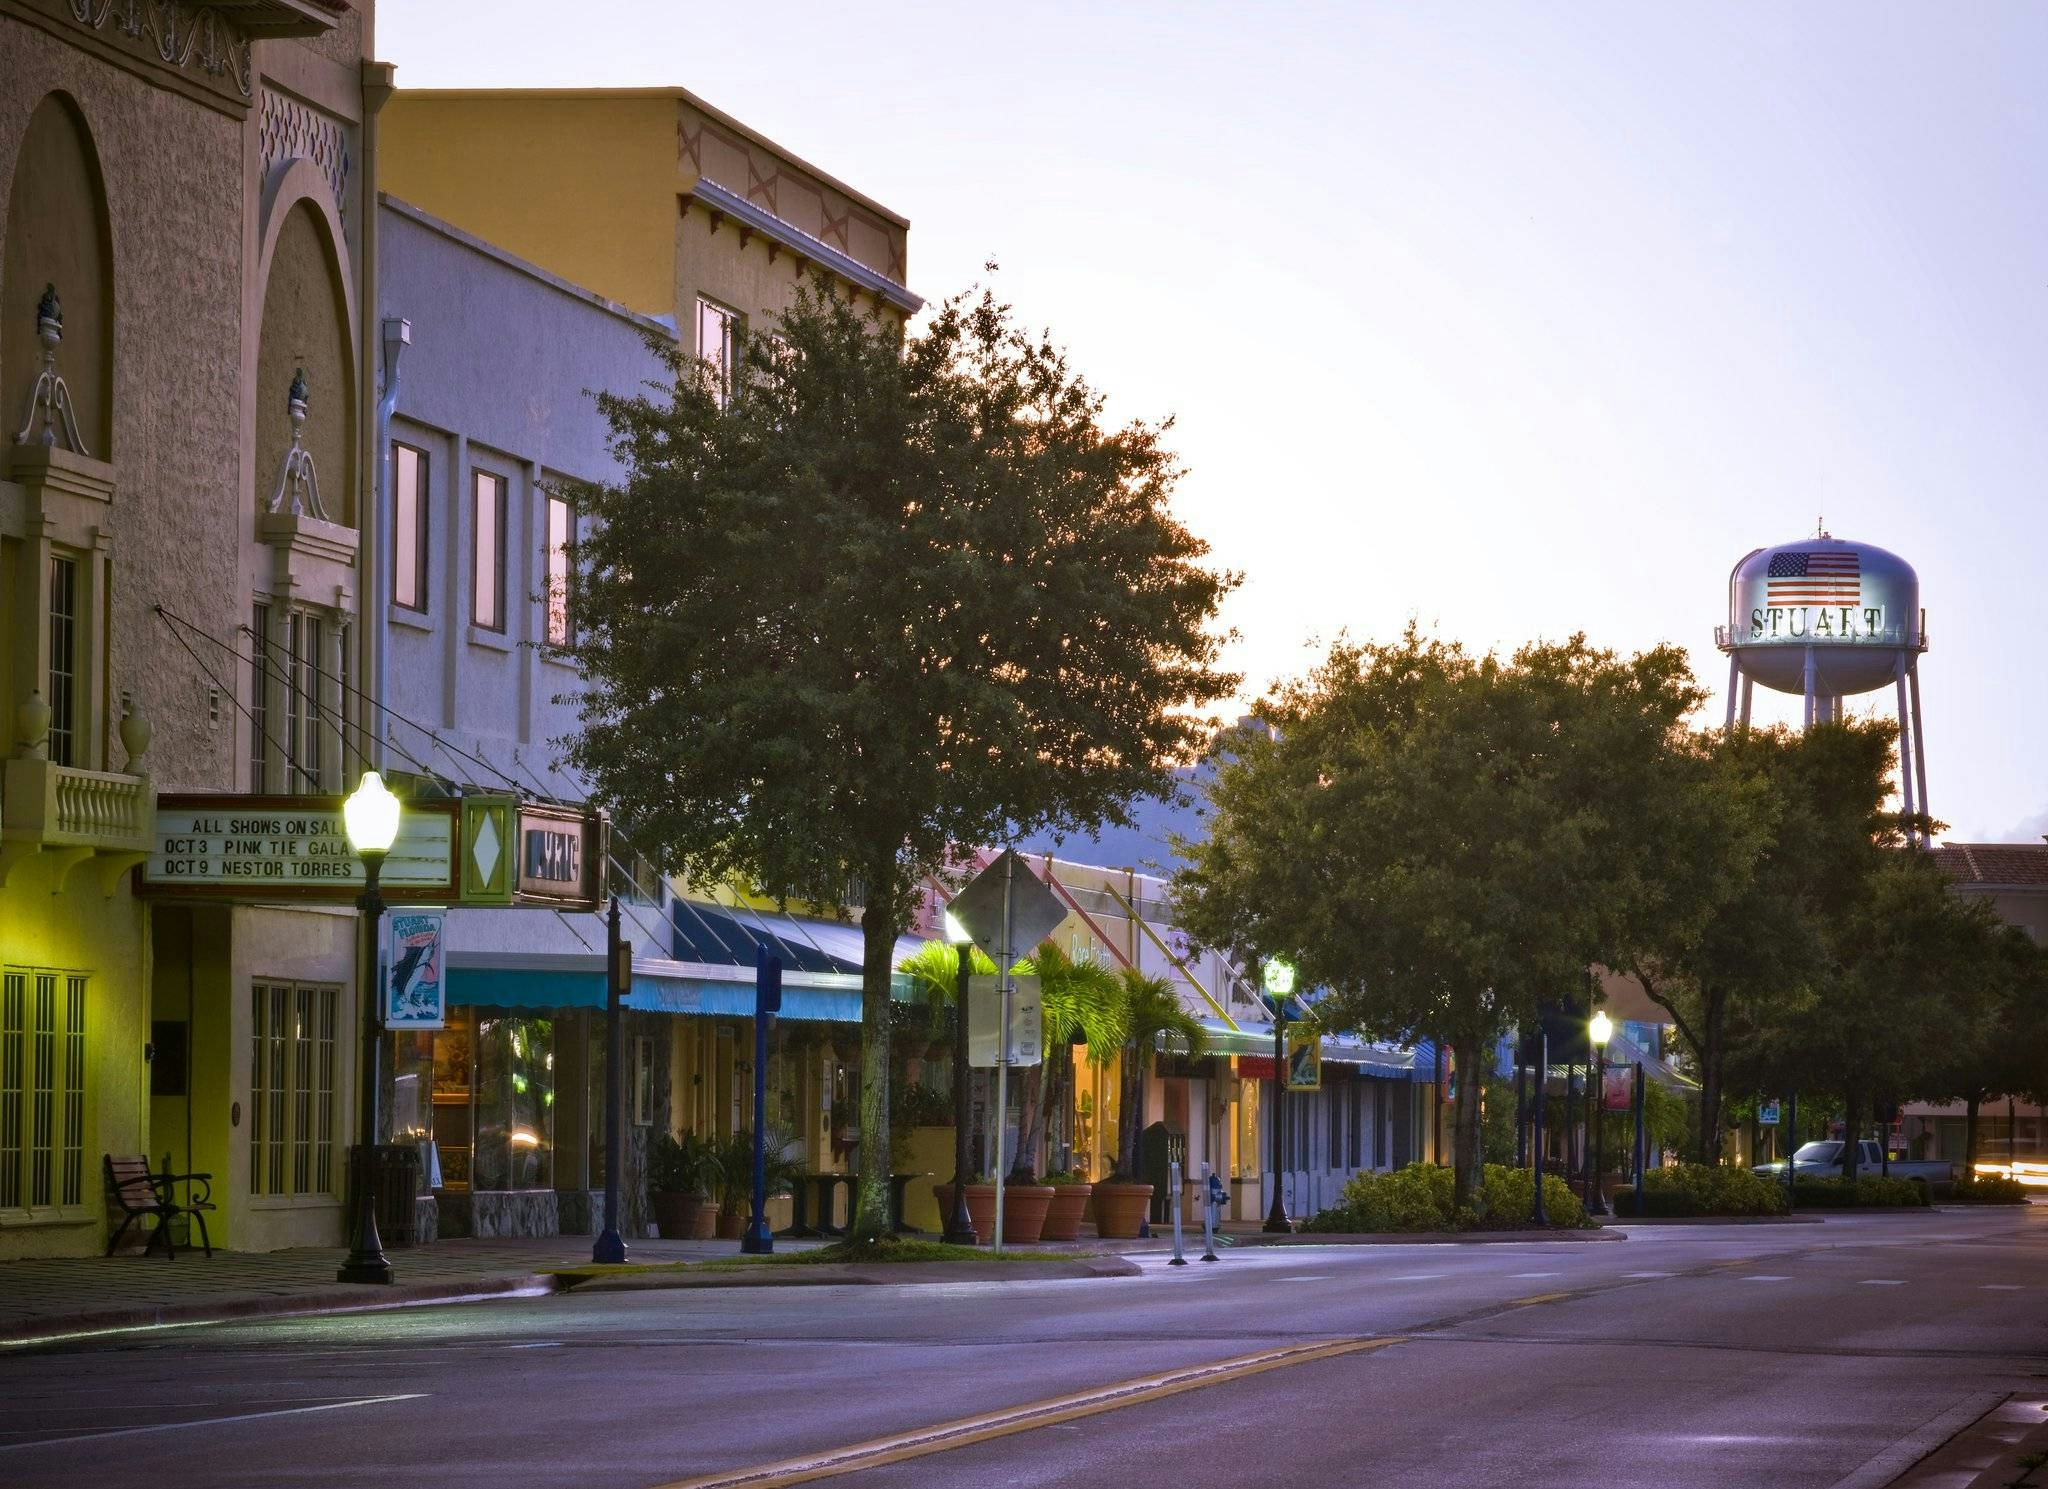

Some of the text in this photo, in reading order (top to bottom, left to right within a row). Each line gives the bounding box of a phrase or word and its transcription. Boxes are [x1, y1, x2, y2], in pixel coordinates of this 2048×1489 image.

[1751, 607, 1881, 638] STUART
[192, 819, 222, 834] ALL
[230, 819, 281, 835] SHOWS
[286, 820, 306, 835] ON
[165, 839, 350, 856] OCT 3 PINK TIE GALA
[525, 829, 579, 881] LYRIC
[165, 860, 352, 877] OCT 9 NESTOR TORRES
